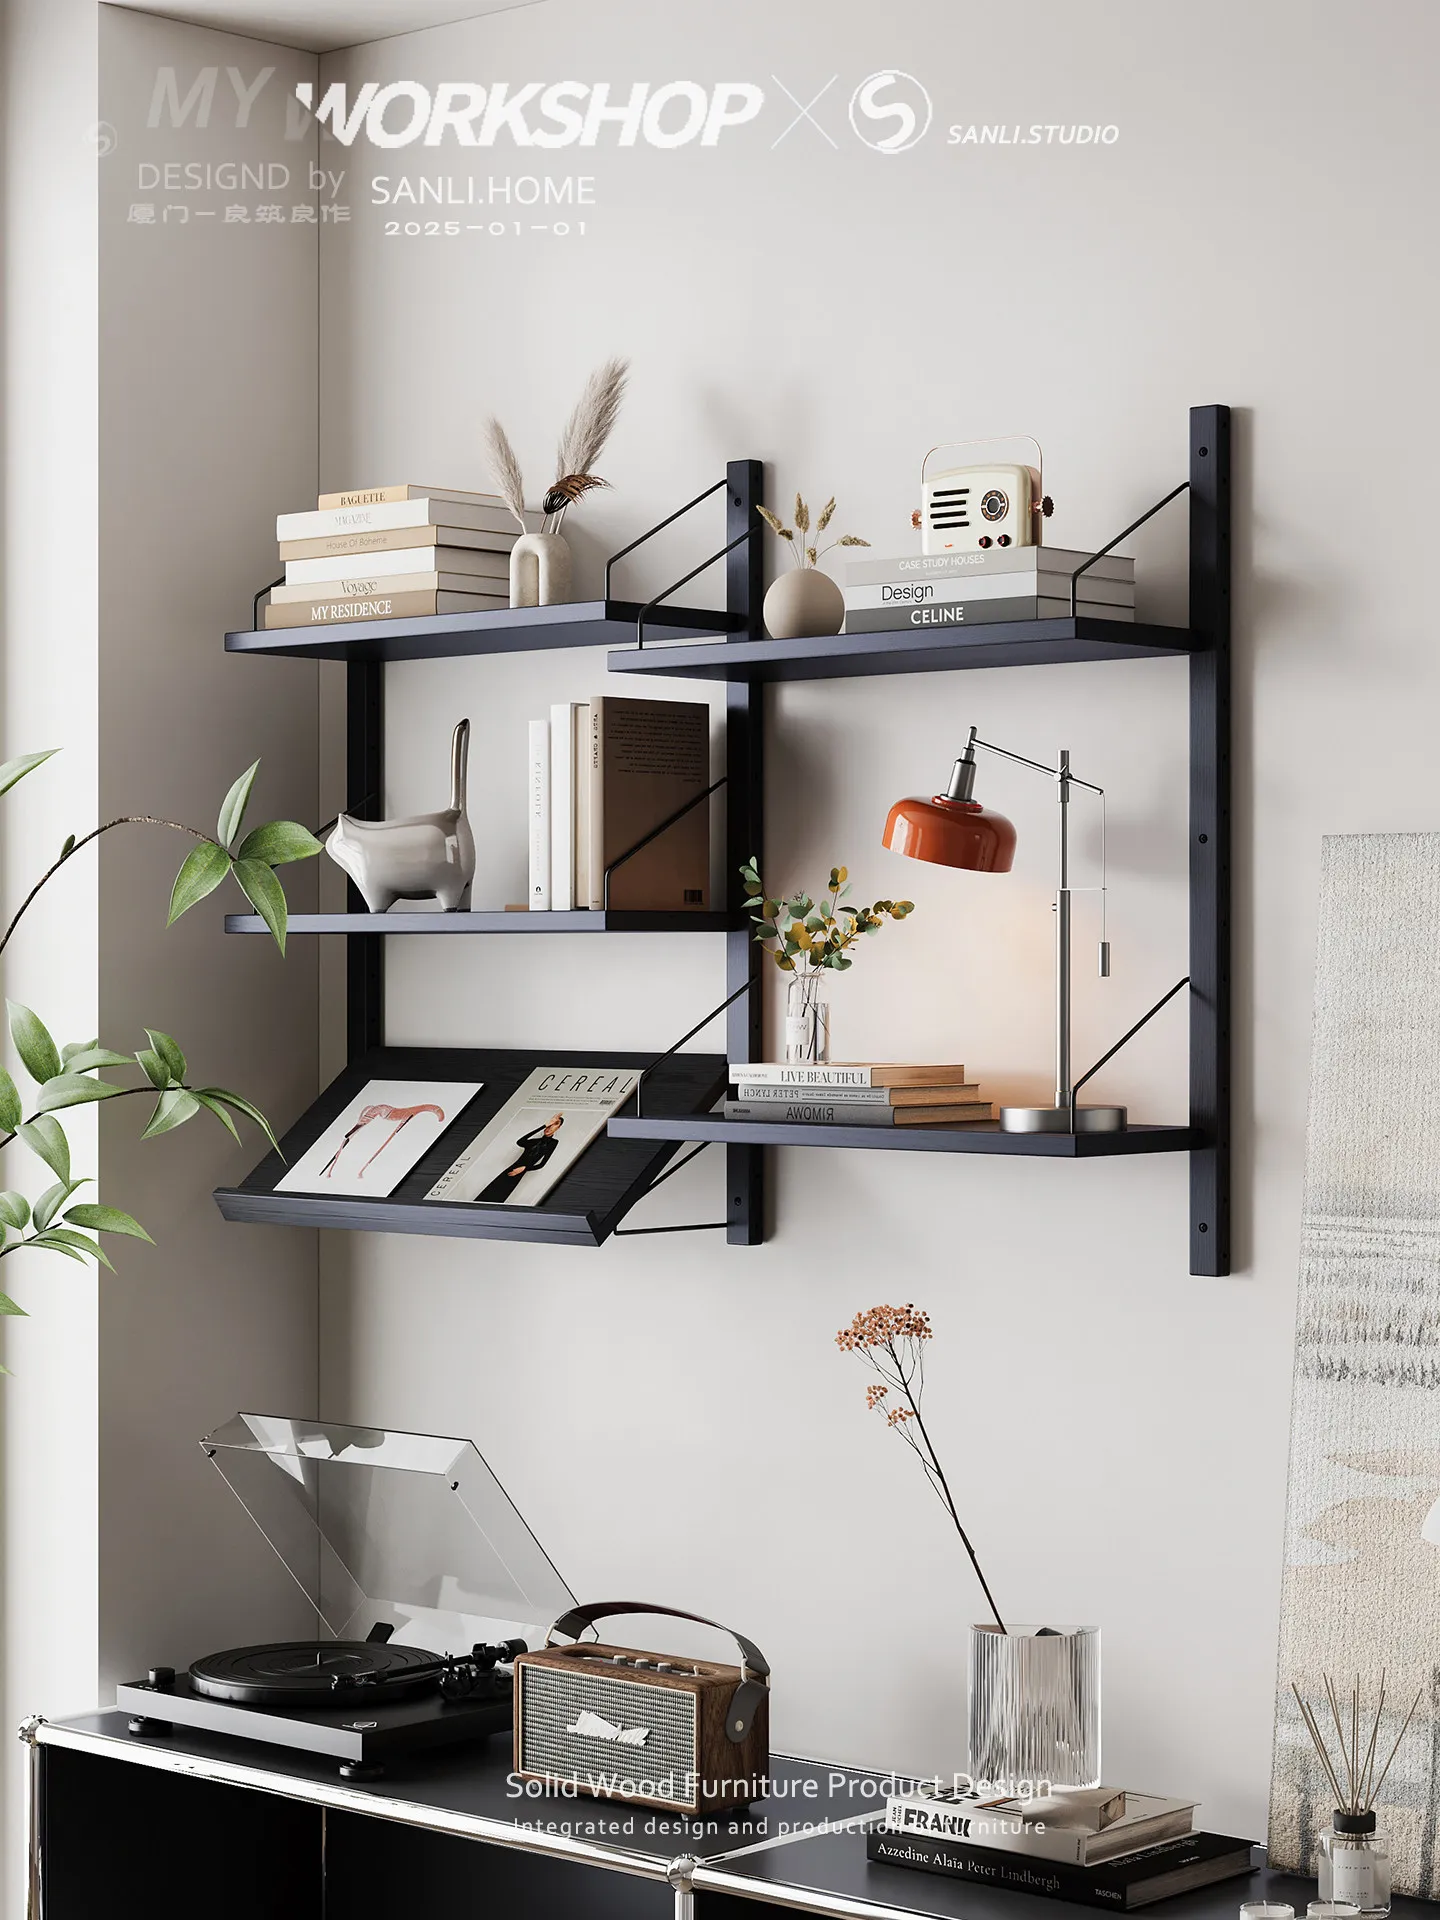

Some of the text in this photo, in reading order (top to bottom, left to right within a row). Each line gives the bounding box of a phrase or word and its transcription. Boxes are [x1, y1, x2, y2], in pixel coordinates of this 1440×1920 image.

[340, 492, 386, 506] BAGUETTE
[335, 512, 372, 526] MAGAZINE
[326, 537, 388, 550] House Of Boheme
[899, 554, 985, 571] CASE STUDY HOUSES
[341, 581, 378, 596] Voyage
[882, 584, 934, 603] Design
[311, 600, 392, 621] MY RESIDENCE
[911, 607, 964, 625] CELINE
[538, 1074, 633, 1094] CEREAL
[780, 1070, 805, 1083] LIVE
[807, 1070, 867, 1085] BEAUTIFUL
[430, 1154, 472, 1197] CEREAL
[904, 1808, 972, 1838] FRANK
[877, 1842, 1061, 1891] Azzedine Alaïa Peter Lindbergh
[1094, 1888, 1122, 1900] TASCHEN
